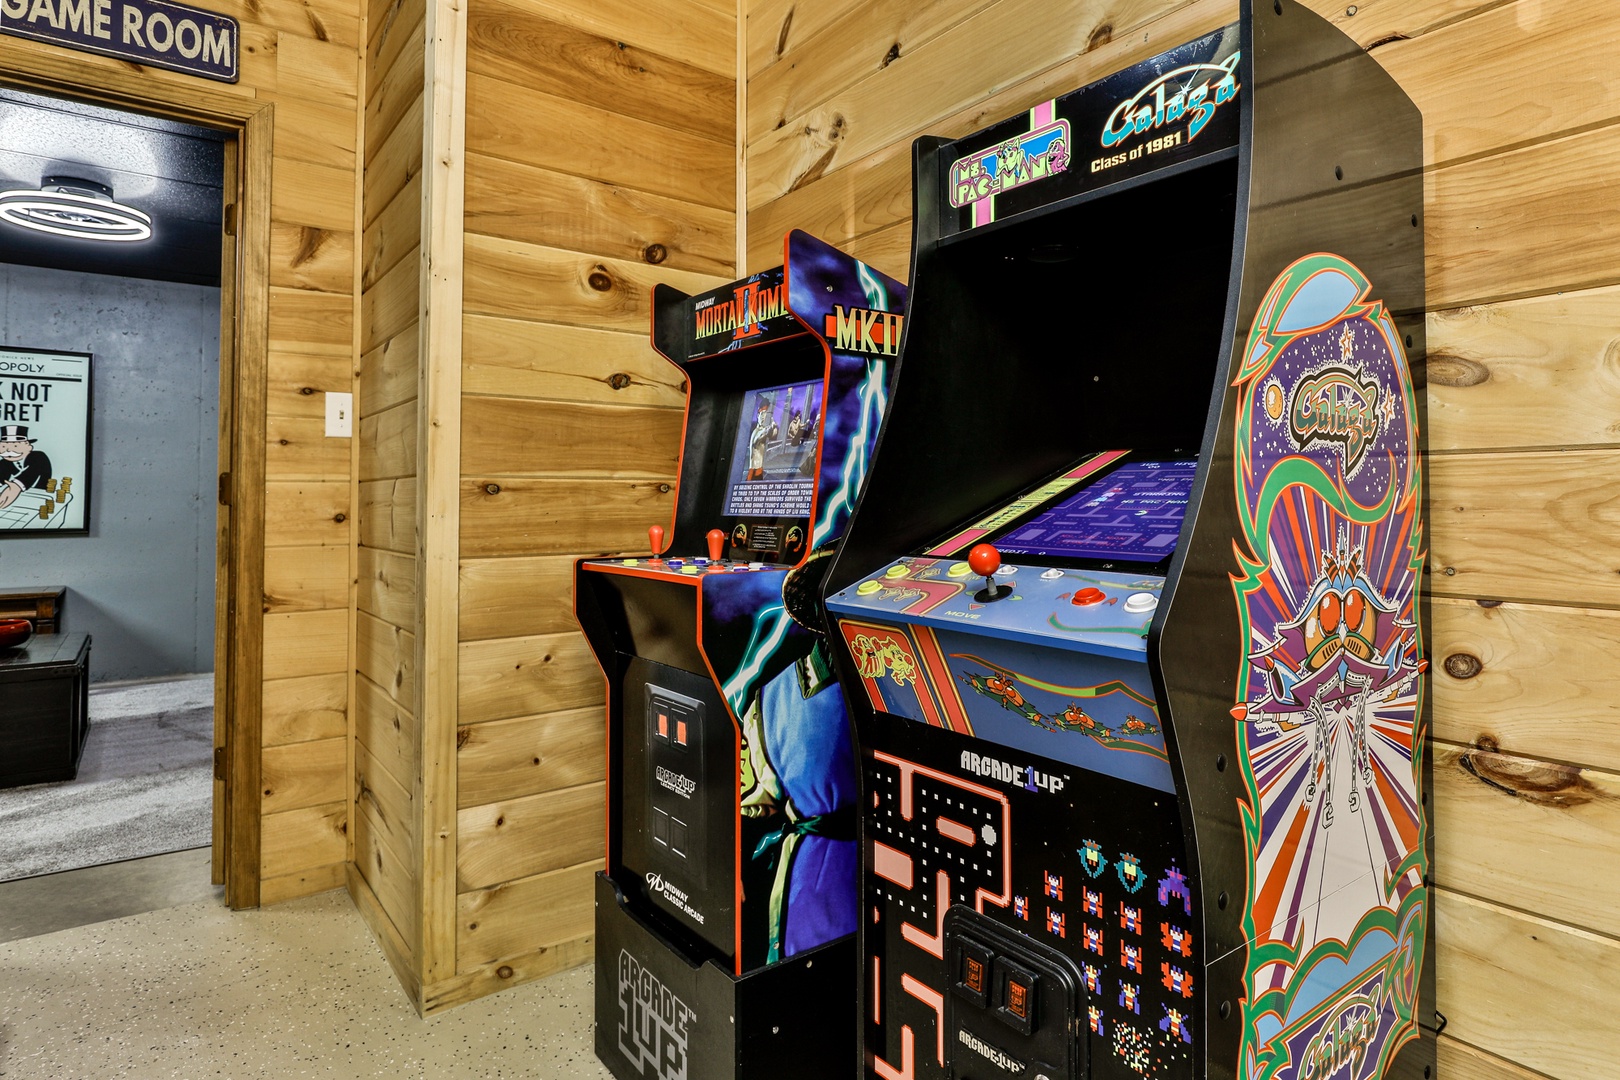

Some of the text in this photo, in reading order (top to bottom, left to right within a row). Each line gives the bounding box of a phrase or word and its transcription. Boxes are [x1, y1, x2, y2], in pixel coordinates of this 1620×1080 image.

[0, 0, 231, 67] GAME ROOM
[1101, 51, 1241, 147] Galaga
[1091, 131, 1181, 173] Class of 1981
[957, 154, 1049, 206] PAC-MAN
[695, 297, 716, 311] MIDWAY
[695, 296, 746, 340] MORTAL
[12, 382, 52, 402] NOT
[0, 402, 43, 422] RET
[1294, 372, 1377, 463] Galaga
[945, 610, 982, 620] MOVE
[660, 780, 691, 800] LEGACY EDITION
[663, 889, 705, 925] CLASSIC ARCADE
[664, 880, 689, 903] MIDWAY
[618, 948, 688, 1048] ARCADE
